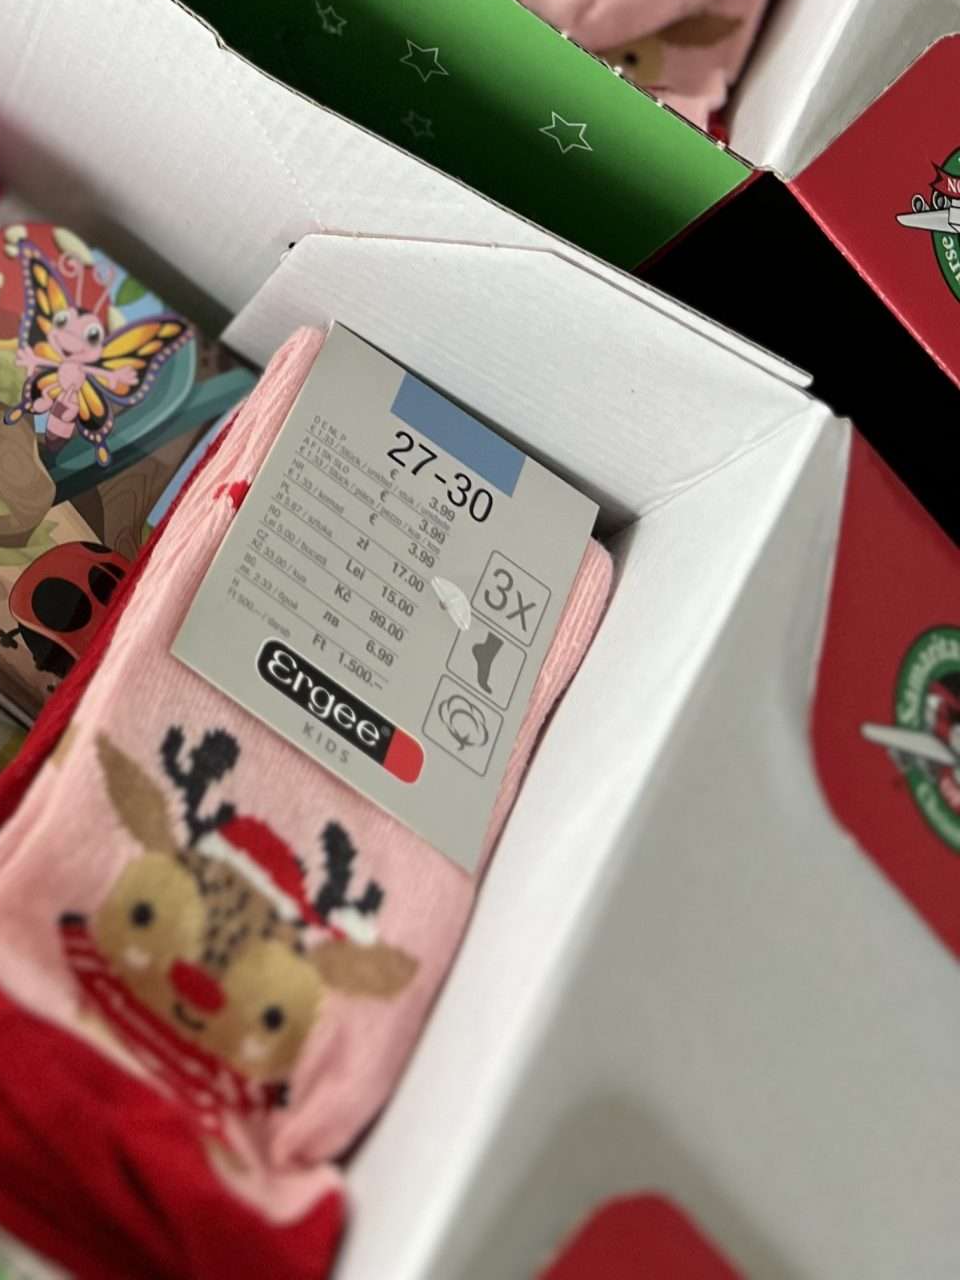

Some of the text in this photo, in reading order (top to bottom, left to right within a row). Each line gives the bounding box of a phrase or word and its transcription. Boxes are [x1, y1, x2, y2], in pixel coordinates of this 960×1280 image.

[383, 428, 499, 525] 27-30
[387, 467, 400, 481] €
[427, 496, 457, 523] 3.99
[377, 489, 389, 503] €
[417, 518, 447, 545] 3.99
[388, 559, 426, 593] 17.00
[406, 542, 437, 569] 3.99
[343, 559, 366, 581] Lei
[377, 584, 416, 617] 15.00
[479, 565, 539, 632] 3x
[310, 632, 329, 652] Ft
[367, 608, 406, 642] 99.00
[364, 639, 395, 667] 6.99
[300, 721, 352, 764] KIDS
